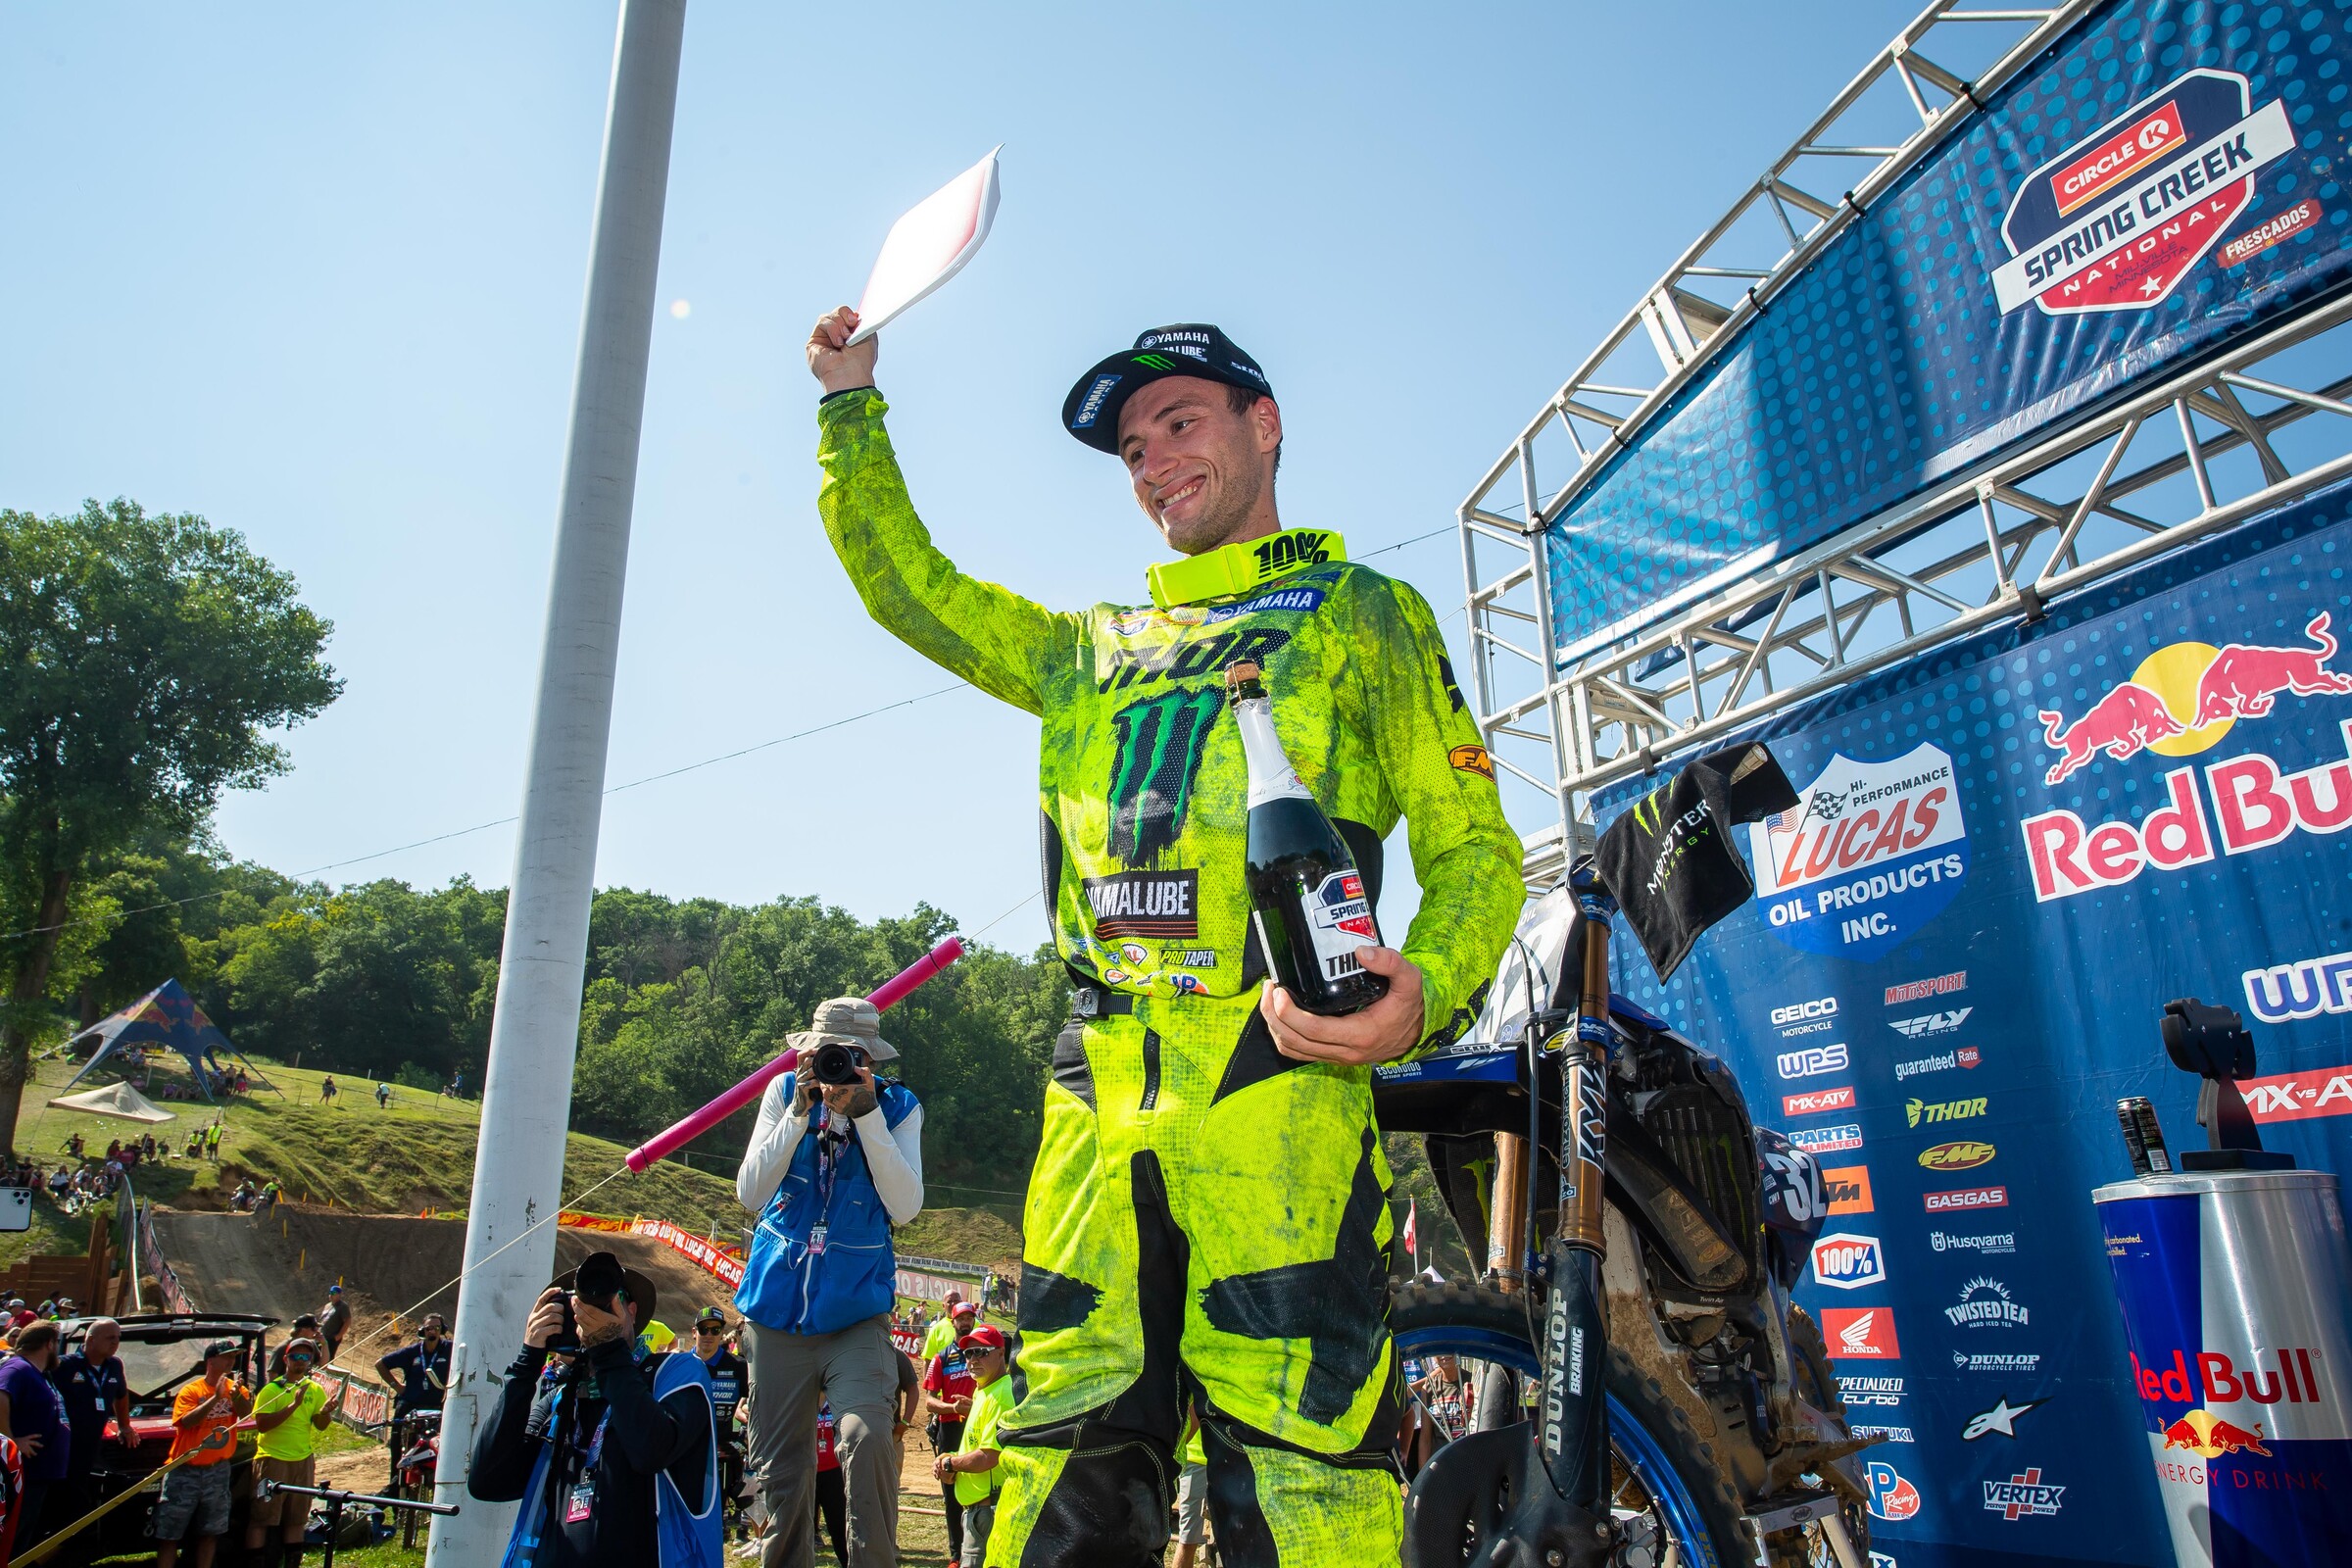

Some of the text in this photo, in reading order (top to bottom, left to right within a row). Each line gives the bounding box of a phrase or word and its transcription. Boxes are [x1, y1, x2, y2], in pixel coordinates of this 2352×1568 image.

[2063, 122, 2167, 195] CIRCLE K
[2024, 131, 2253, 289] SPRING CREEK
[2226, 204, 2310, 259] FRESCADOS
[2064, 200, 2227, 297] NATIONAL
[1157, 332, 1209, 344] YAMAHA
[1082, 378, 1112, 413] YAMAHA
[1253, 532, 1330, 580] 100%
[1234, 591, 1313, 616] YAMAHA
[1849, 780, 1867, 793] HI-
[1852, 766, 1950, 808] PERFORMANCE
[1777, 786, 1947, 888] LUCAS
[2024, 770, 2212, 901] Red
[1769, 854, 1964, 927] OIL PRODUCTS
[1330, 902, 1366, 920] SPRING
[1841, 911, 1897, 944] INC.
[1771, 997, 1838, 1025] GEICO
[1905, 1006, 1973, 1035] FLY
[1782, 1021, 1833, 1038] MOTORCYCLE
[1908, 1027, 1958, 1040] RACING
[1778, 1044, 1848, 1079] WPS
[1895, 1050, 1978, 1081] guaranteed Rate
[1788, 1097, 1815, 1112] MX
[1820, 1091, 1850, 1107] ATV
[1924, 1098, 1988, 1123] THOR
[1788, 1125, 1861, 1146] PARTS
[1798, 1137, 1862, 1153] NLIMITED
[1921, 1145, 1994, 1166] FMF
[1765, 1150, 1830, 1222] 32
[1927, 1190, 2003, 1209] GASGAS
[1946, 1232, 2014, 1250] Husqvarna
[716, 1257, 743, 1285] LUCAS
[1820, 1246, 1873, 1276] 100%
[1944, 1299, 2030, 1326] TWISTED TEA
[1570, 1326, 1584, 1396] BRAKING
[1842, 1346, 1882, 1354] HONDA
[1970, 1354, 2039, 1364] DUNLOP
[1544, 1288, 1568, 1456] DUNLOP
[2196, 1348, 2321, 1405] Bull
[2232, 1468, 2328, 1491] DRINK
[1886, 1493, 1918, 1511] Racing
[1984, 1482, 2064, 1507] VERTEX
